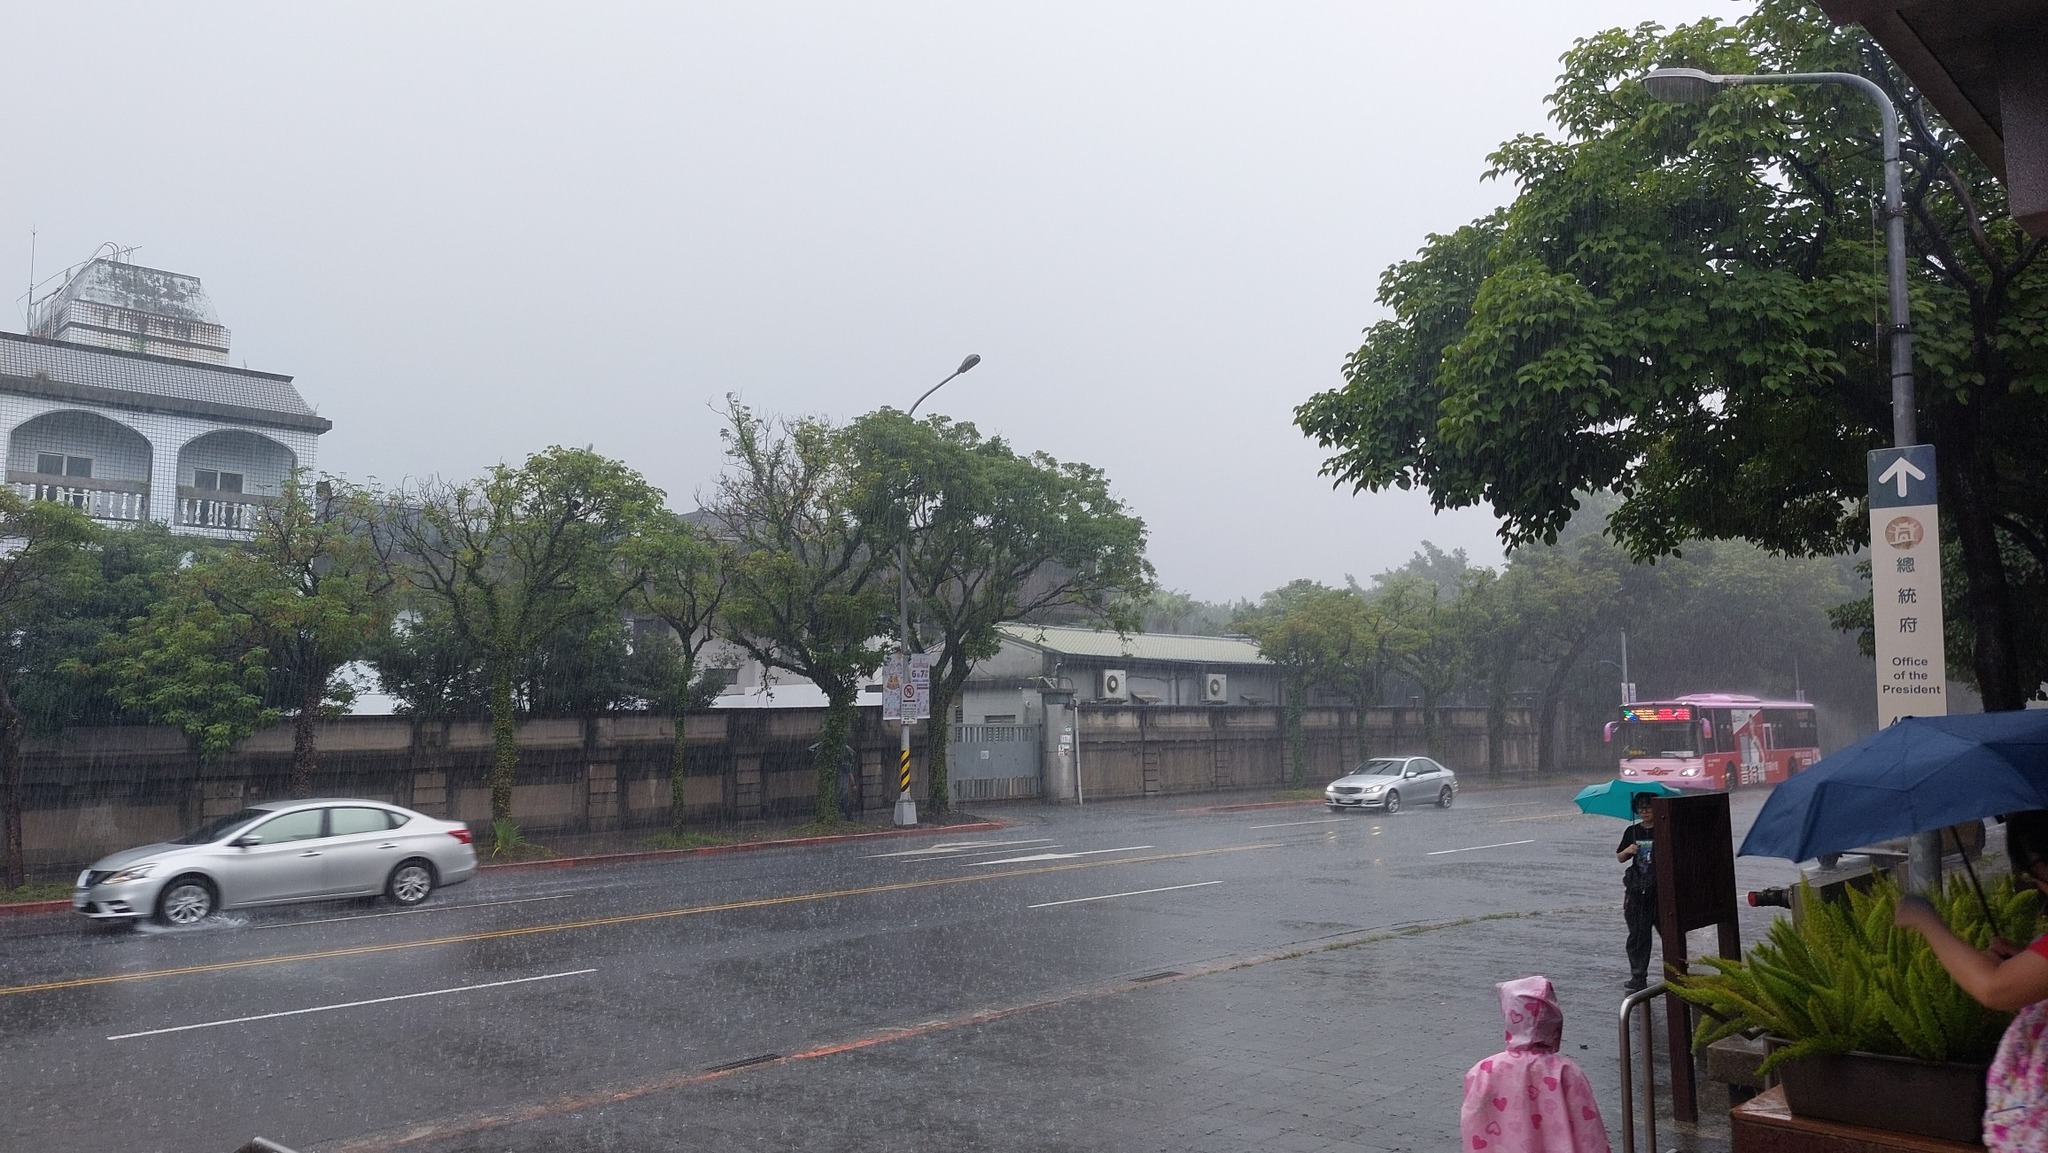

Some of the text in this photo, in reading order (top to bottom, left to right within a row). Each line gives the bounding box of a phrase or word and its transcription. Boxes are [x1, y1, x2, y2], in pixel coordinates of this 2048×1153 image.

[1896, 557, 1918, 633] 總統府
[1892, 657, 1928, 666] Office
[1893, 671, 1928, 680] of the
[1882, 685, 1941, 694] President
